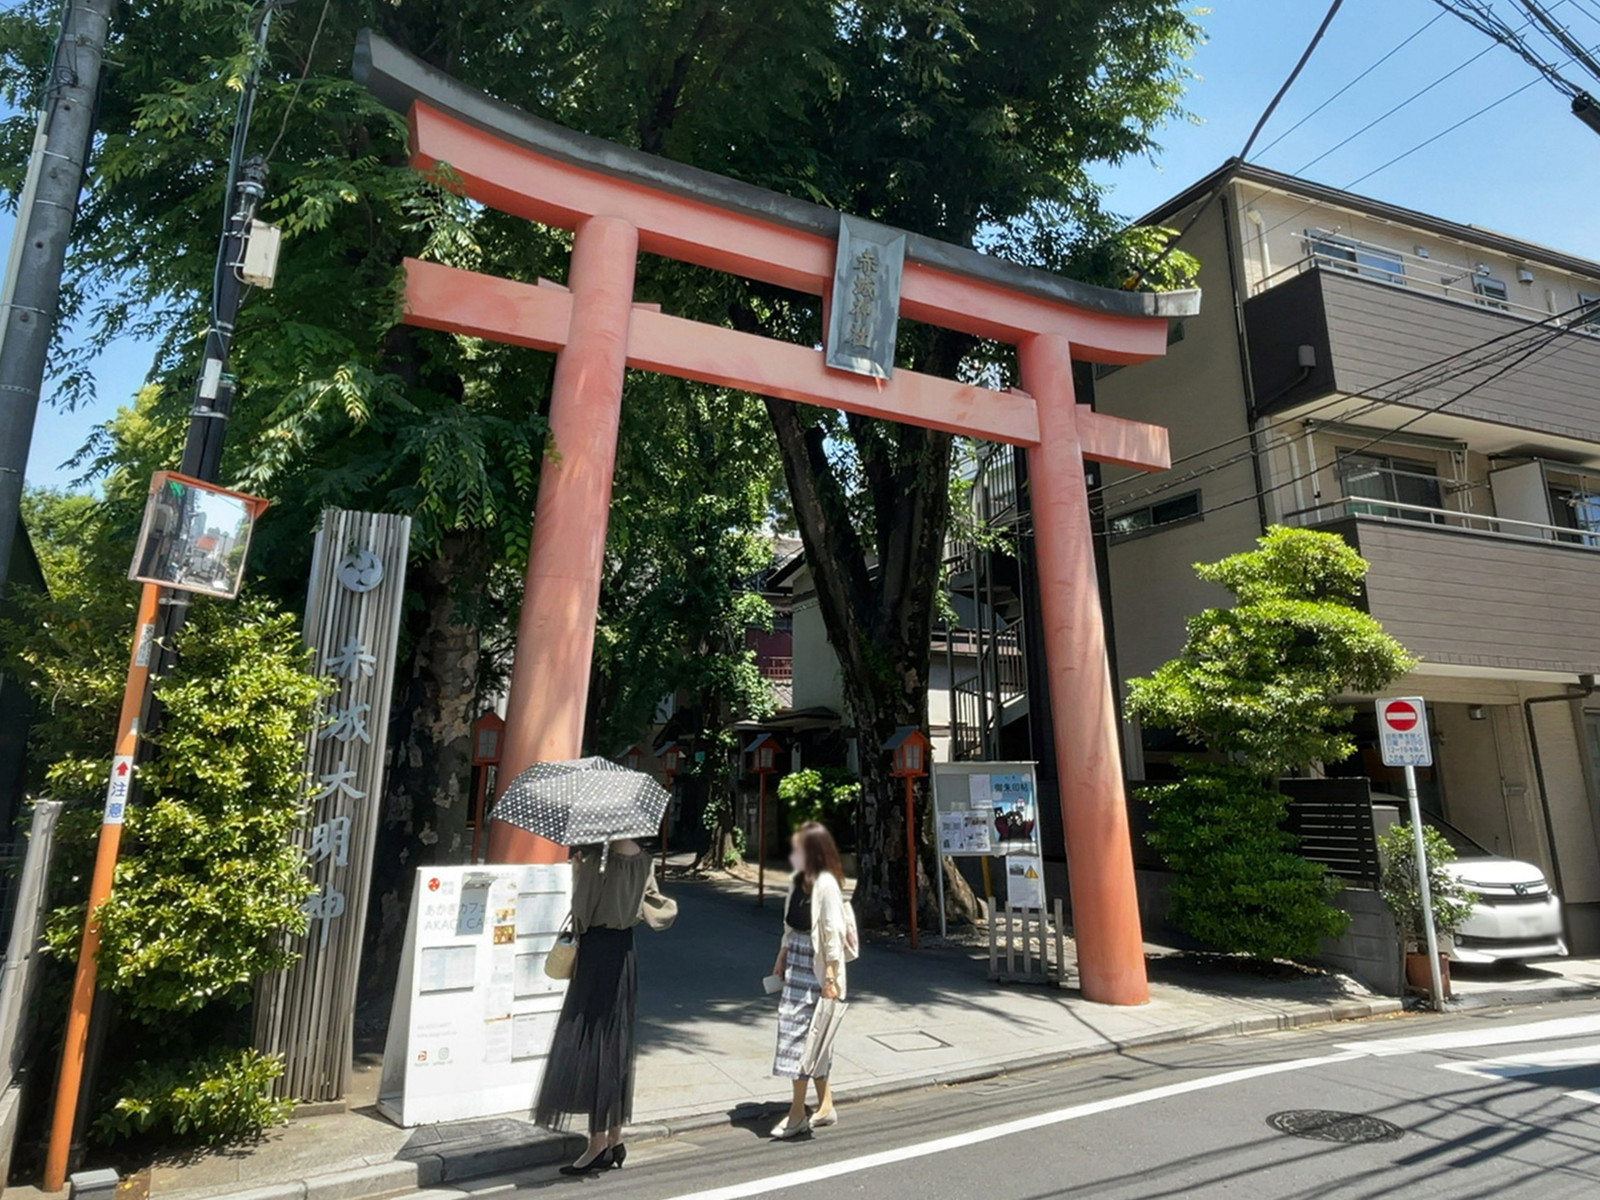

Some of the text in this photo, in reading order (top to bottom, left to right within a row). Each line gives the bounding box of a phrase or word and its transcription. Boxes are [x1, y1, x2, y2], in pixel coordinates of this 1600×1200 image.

[846, 249, 878, 350] 赤城神社
[107, 781, 127, 819] 注意
[300, 635, 377, 952] 赤城大明神
[424, 919, 462, 931] AKAGI
